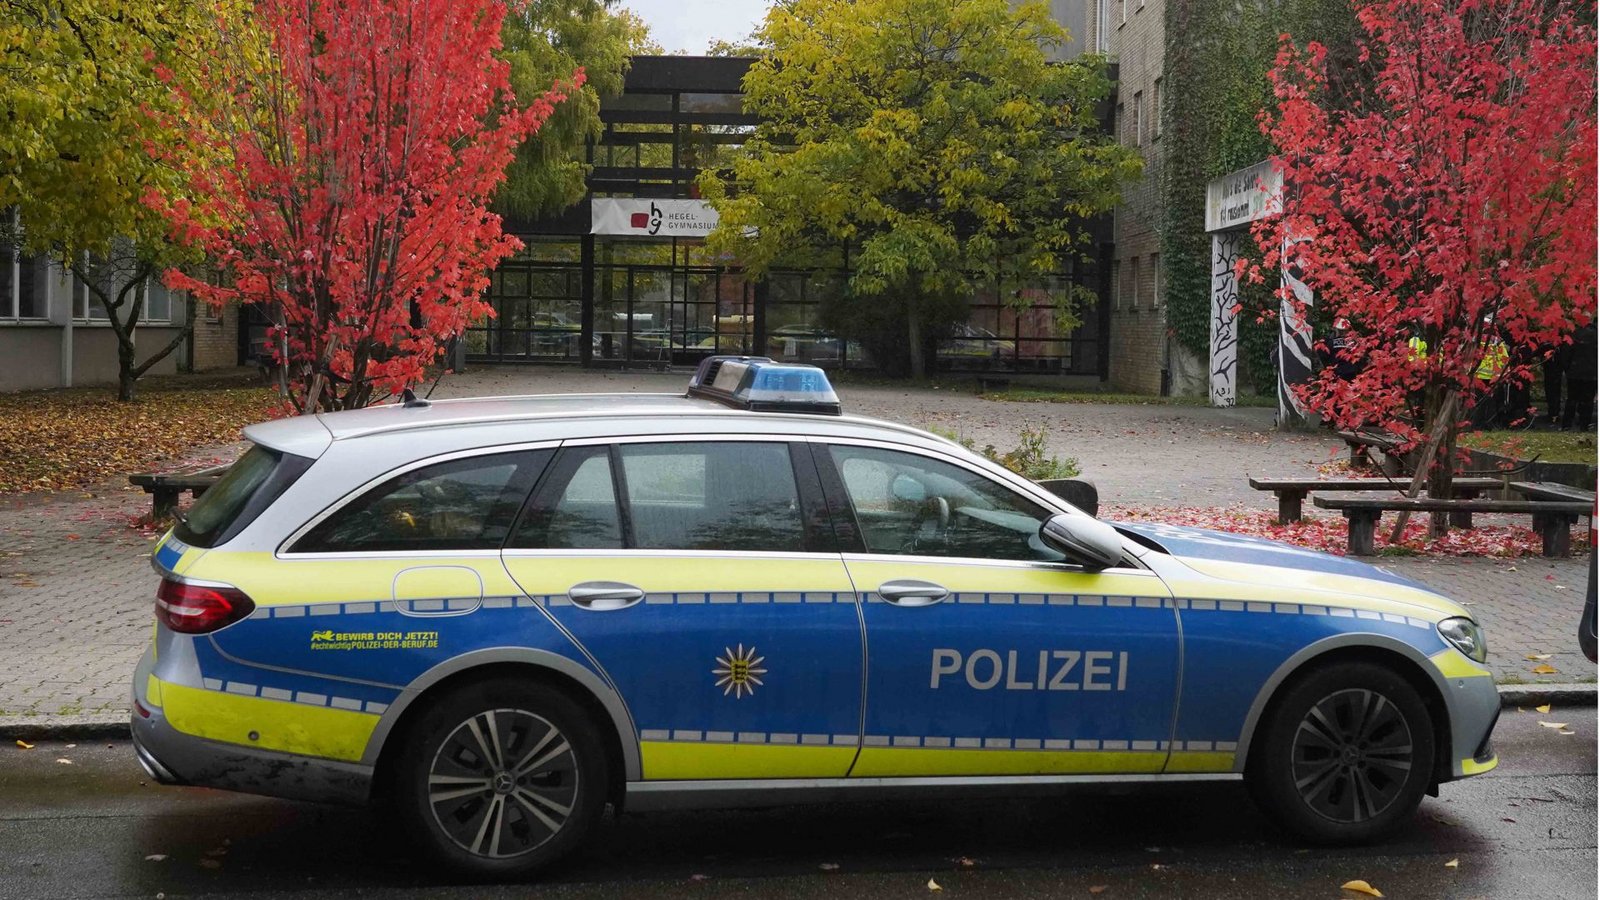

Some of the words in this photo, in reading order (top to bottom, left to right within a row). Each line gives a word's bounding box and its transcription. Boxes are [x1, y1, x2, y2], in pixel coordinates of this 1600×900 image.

[335, 633, 375, 641] BEWIRB
[376, 632, 402, 641] DICH
[404, 631, 439, 641] JETZT!
[930, 648, 1129, 691] POLIZEI
